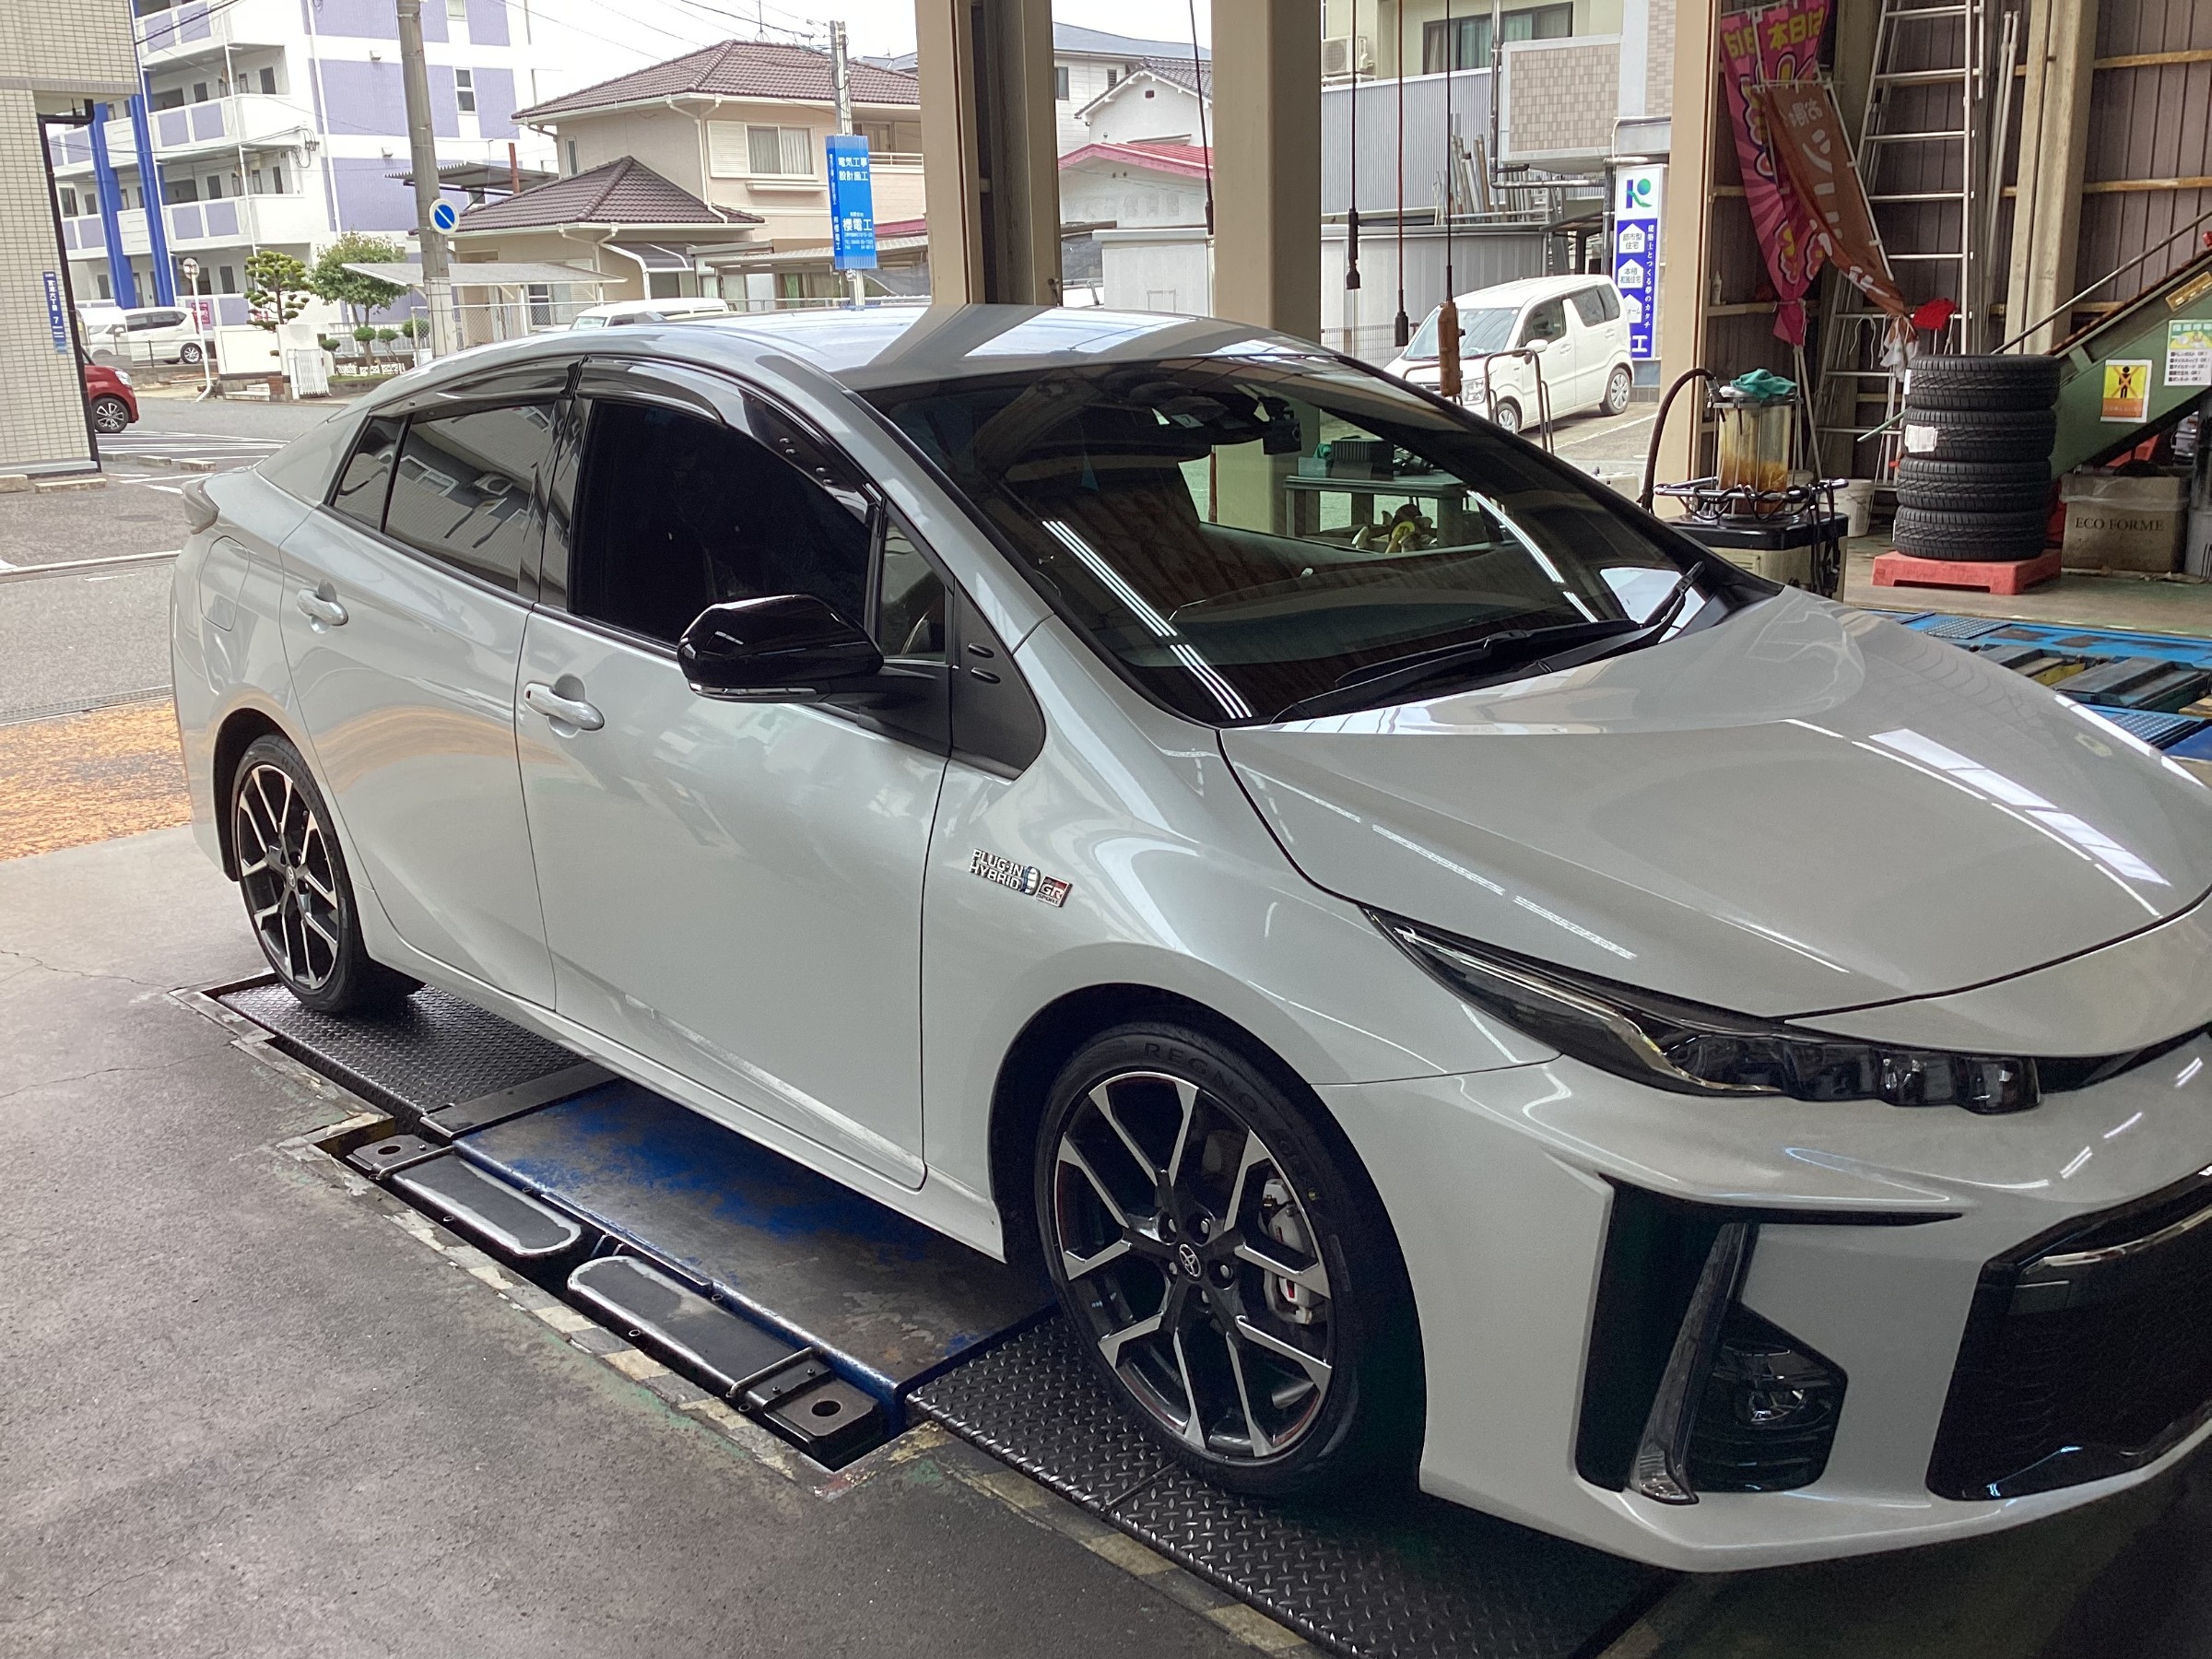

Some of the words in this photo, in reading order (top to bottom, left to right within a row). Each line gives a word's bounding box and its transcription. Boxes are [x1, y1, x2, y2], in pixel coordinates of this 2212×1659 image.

[838, 157, 867, 167] 電気工事
[839, 171, 868, 181] 設計施工
[1626, 241, 1639, 250] 住宅
[2076, 517, 2105, 530] ECO
[2109, 518, 2165, 532] FORME
[969, 858, 1021, 891] HYBRID
[1041, 883, 1065, 900] GR
[1037, 893, 1060, 904] SPORT
